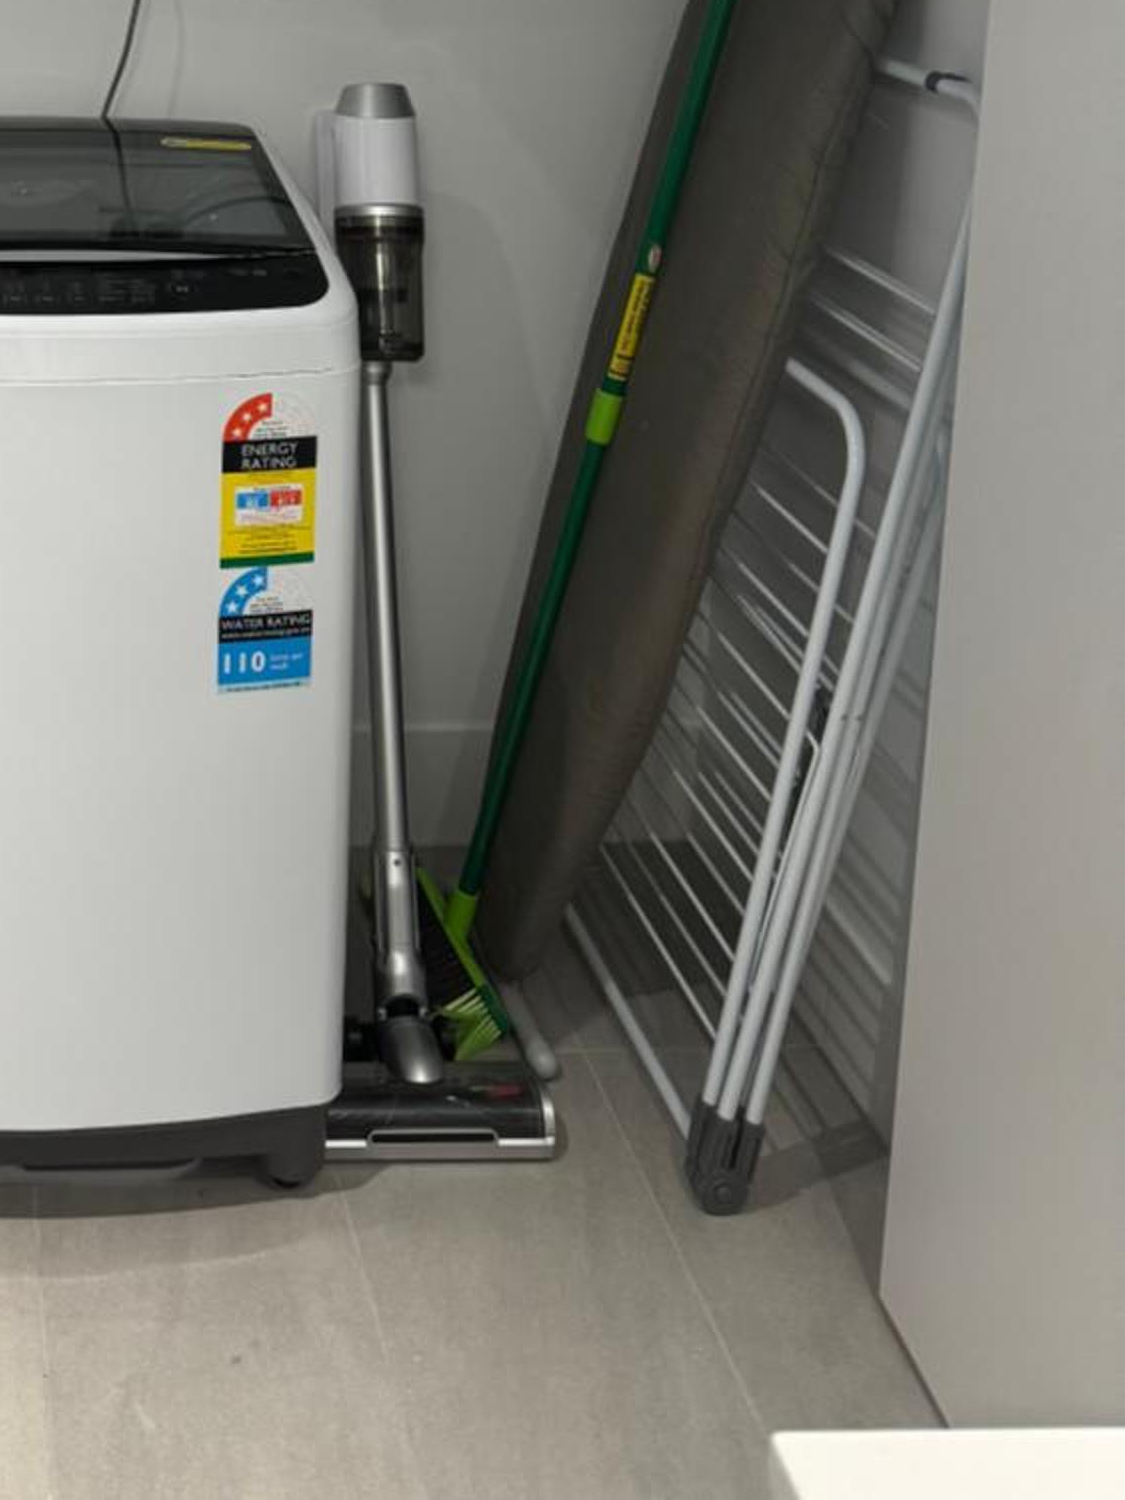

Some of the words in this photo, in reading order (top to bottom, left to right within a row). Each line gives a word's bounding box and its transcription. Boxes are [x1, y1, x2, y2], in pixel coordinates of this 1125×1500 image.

[241, 441, 298, 456] ENERGY
[240, 455, 296, 470] RATING
[220, 616, 264, 630] WATER
[266, 612, 311, 628] RATING
